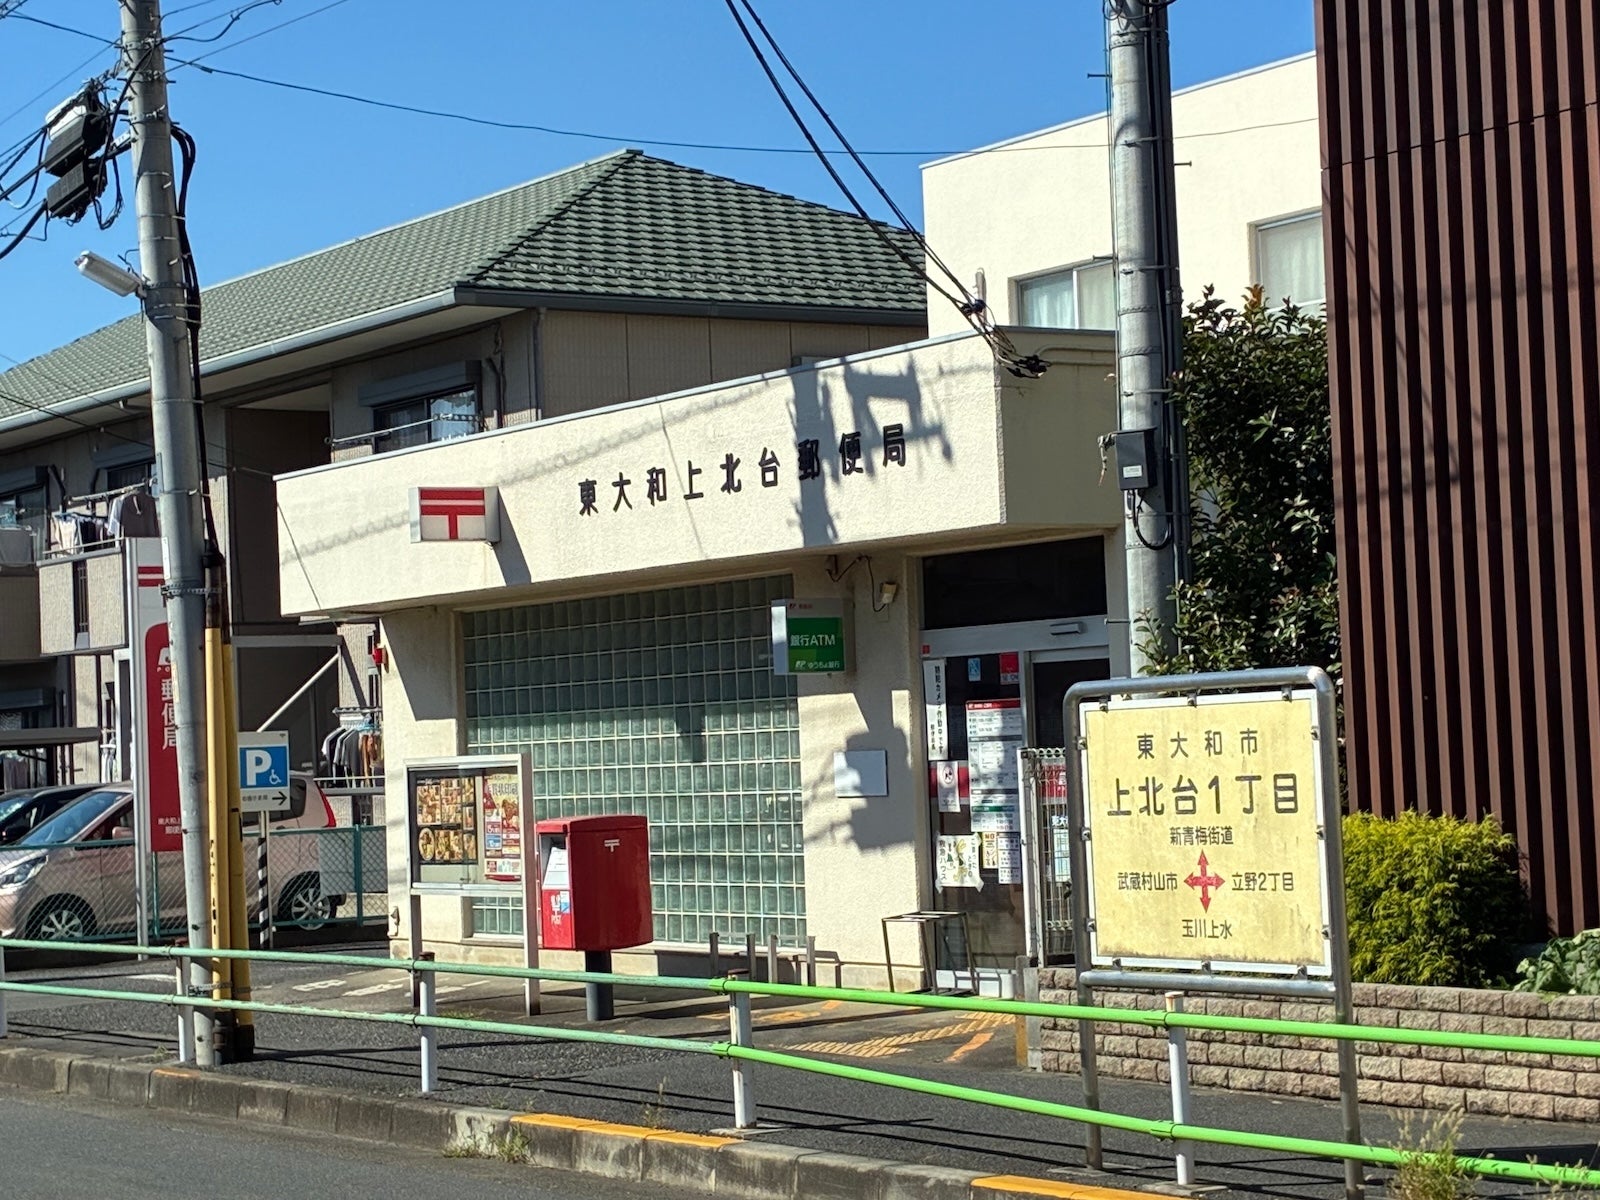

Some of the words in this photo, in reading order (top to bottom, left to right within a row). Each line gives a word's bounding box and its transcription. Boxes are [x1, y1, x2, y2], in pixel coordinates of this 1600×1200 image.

[578, 423, 906, 516] 東大和上北台郵便局
[790, 634, 836, 647] 銀行ATM
[1136, 728, 1259, 760] 東大和市
[246, 749, 273, 786] P
[1107, 773, 1299, 817] 上北台1丁目
[1169, 825, 1234, 847] 新青梅街道
[1117, 871, 1178, 891] 武蔵村山市
[1231, 871, 1295, 891] 立野2丁目
[1181, 918, 1233, 940] 玉川上水
